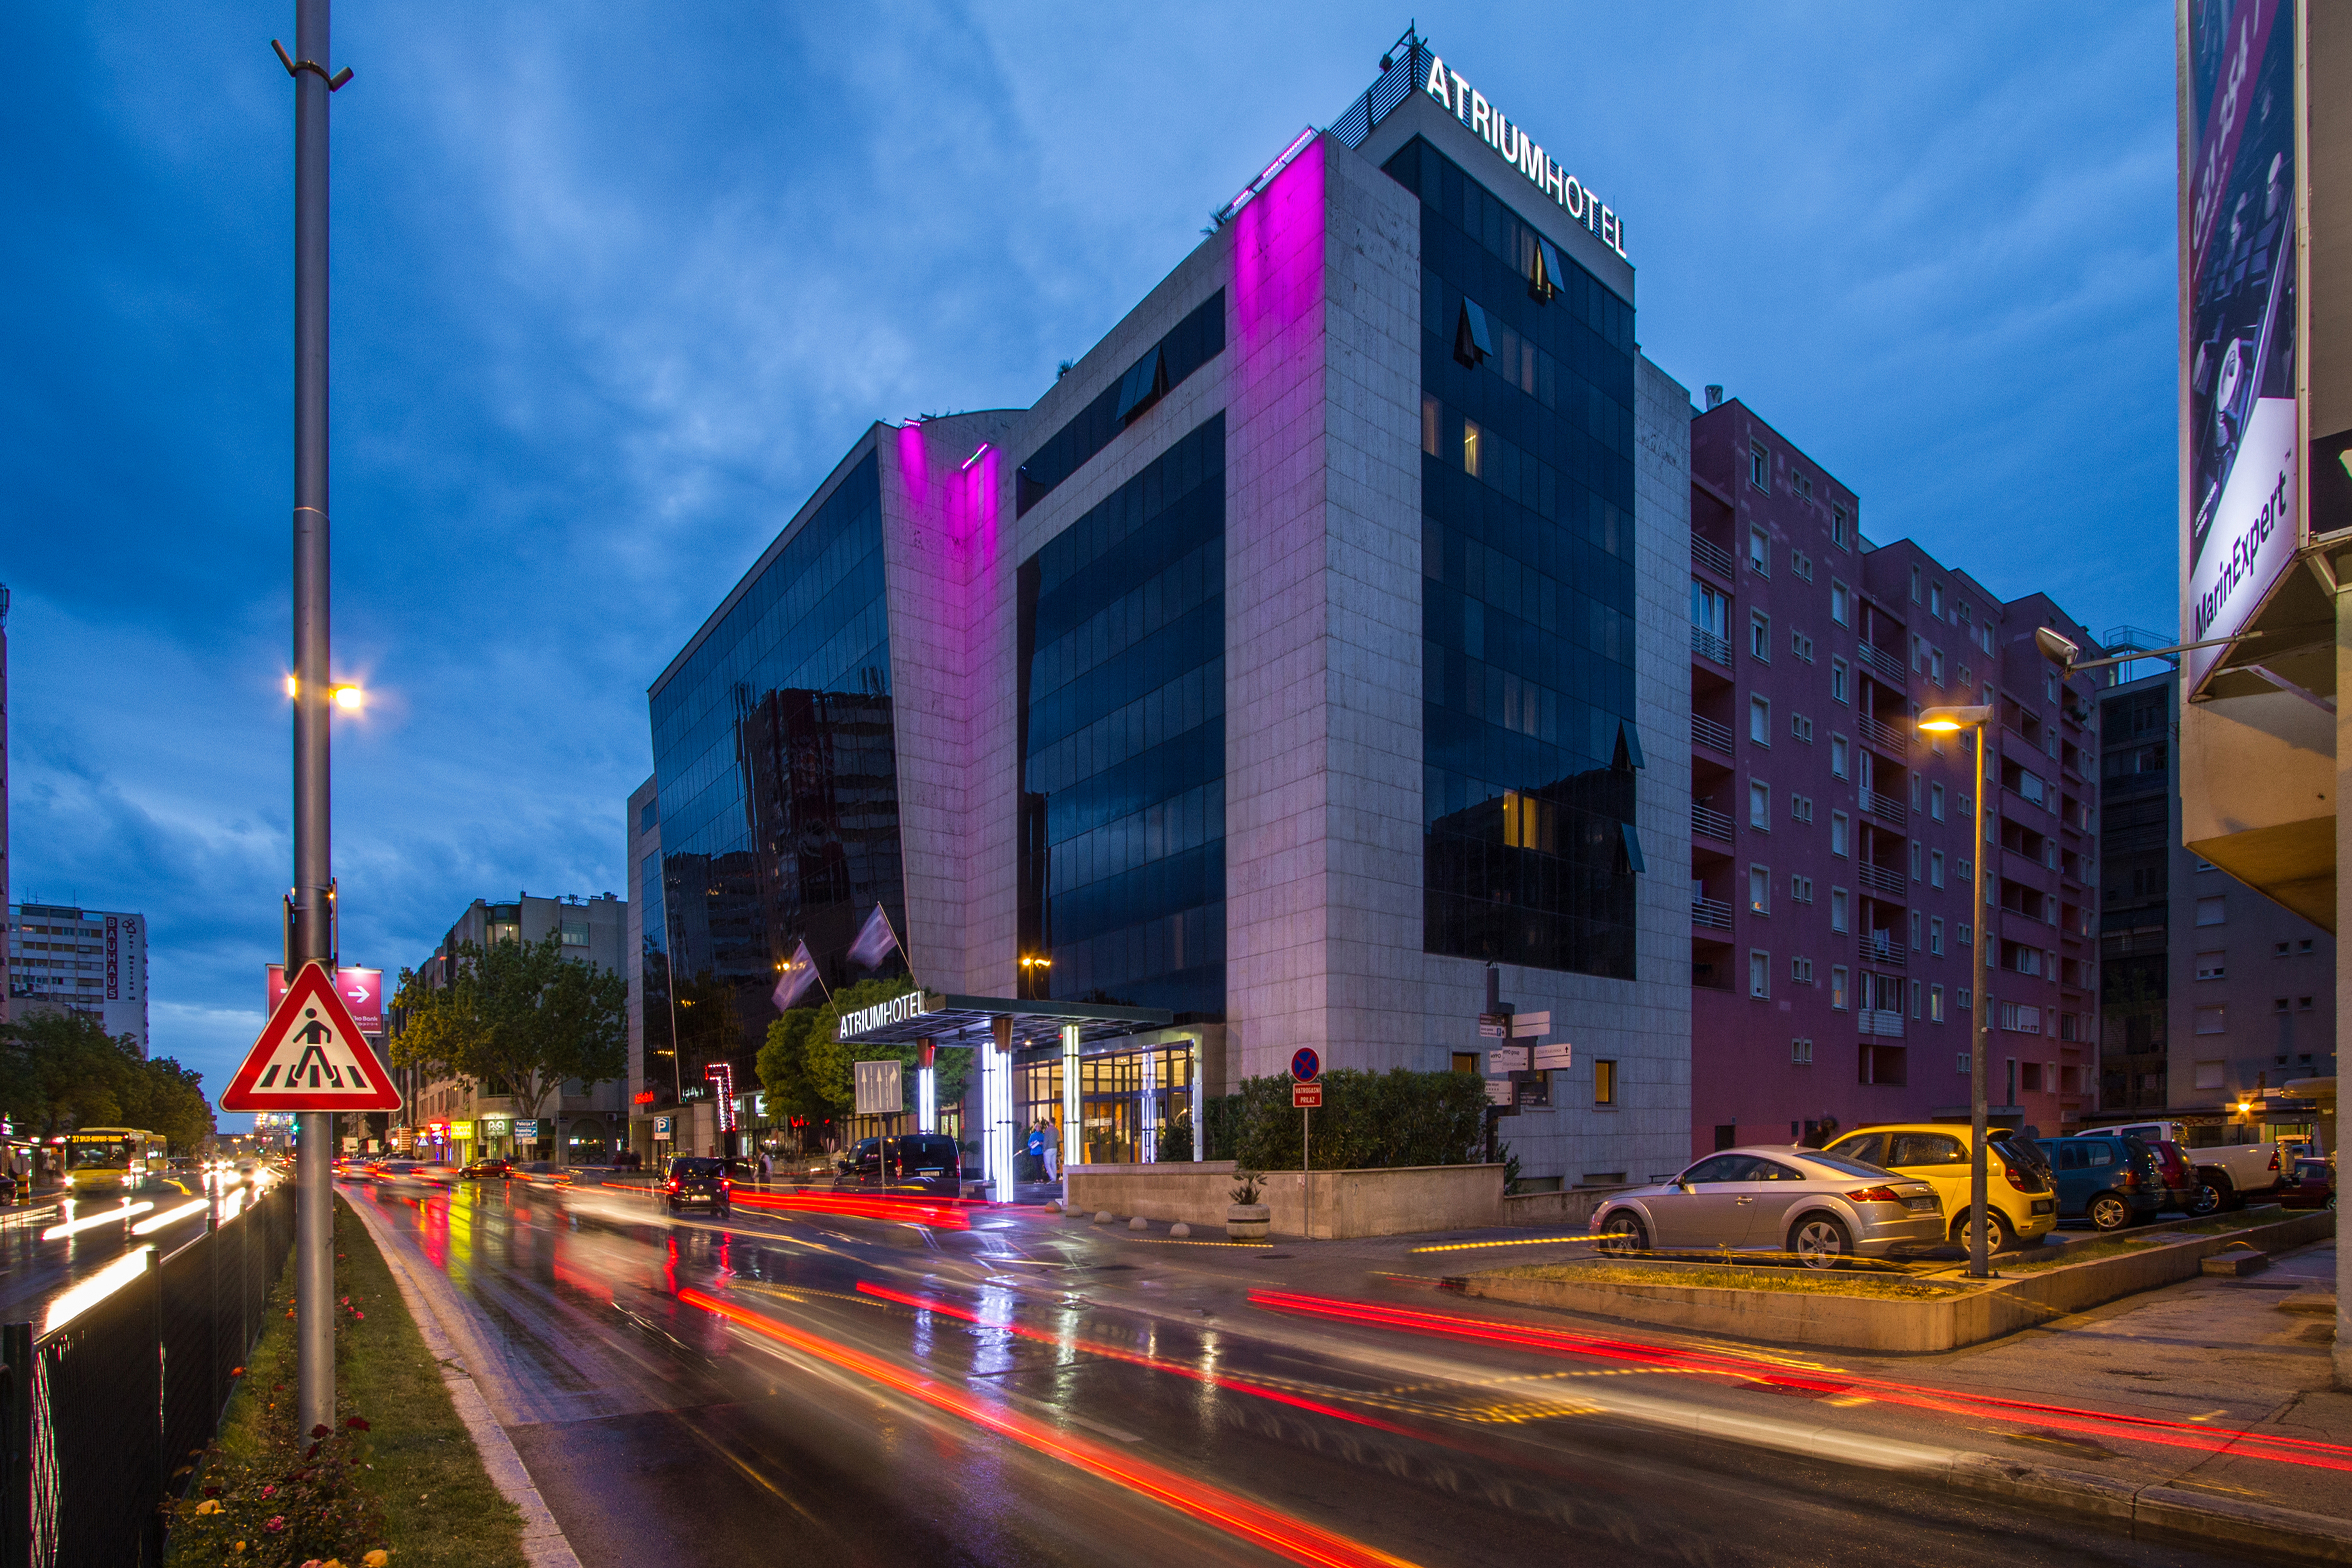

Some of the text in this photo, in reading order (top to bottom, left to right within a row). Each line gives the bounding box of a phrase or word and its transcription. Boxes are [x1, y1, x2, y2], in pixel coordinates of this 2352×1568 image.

[1426, 56, 1627, 259] ATRIUMHOTEL
[2195, 470, 2286, 642] MarinExpert
[108, 918, 116, 998] BAUHAUS
[840, 991, 925, 1039] ATRIUMHOTEL
[657, 1121, 666, 1132] P
[722, 1078, 732, 1128] CASINO
